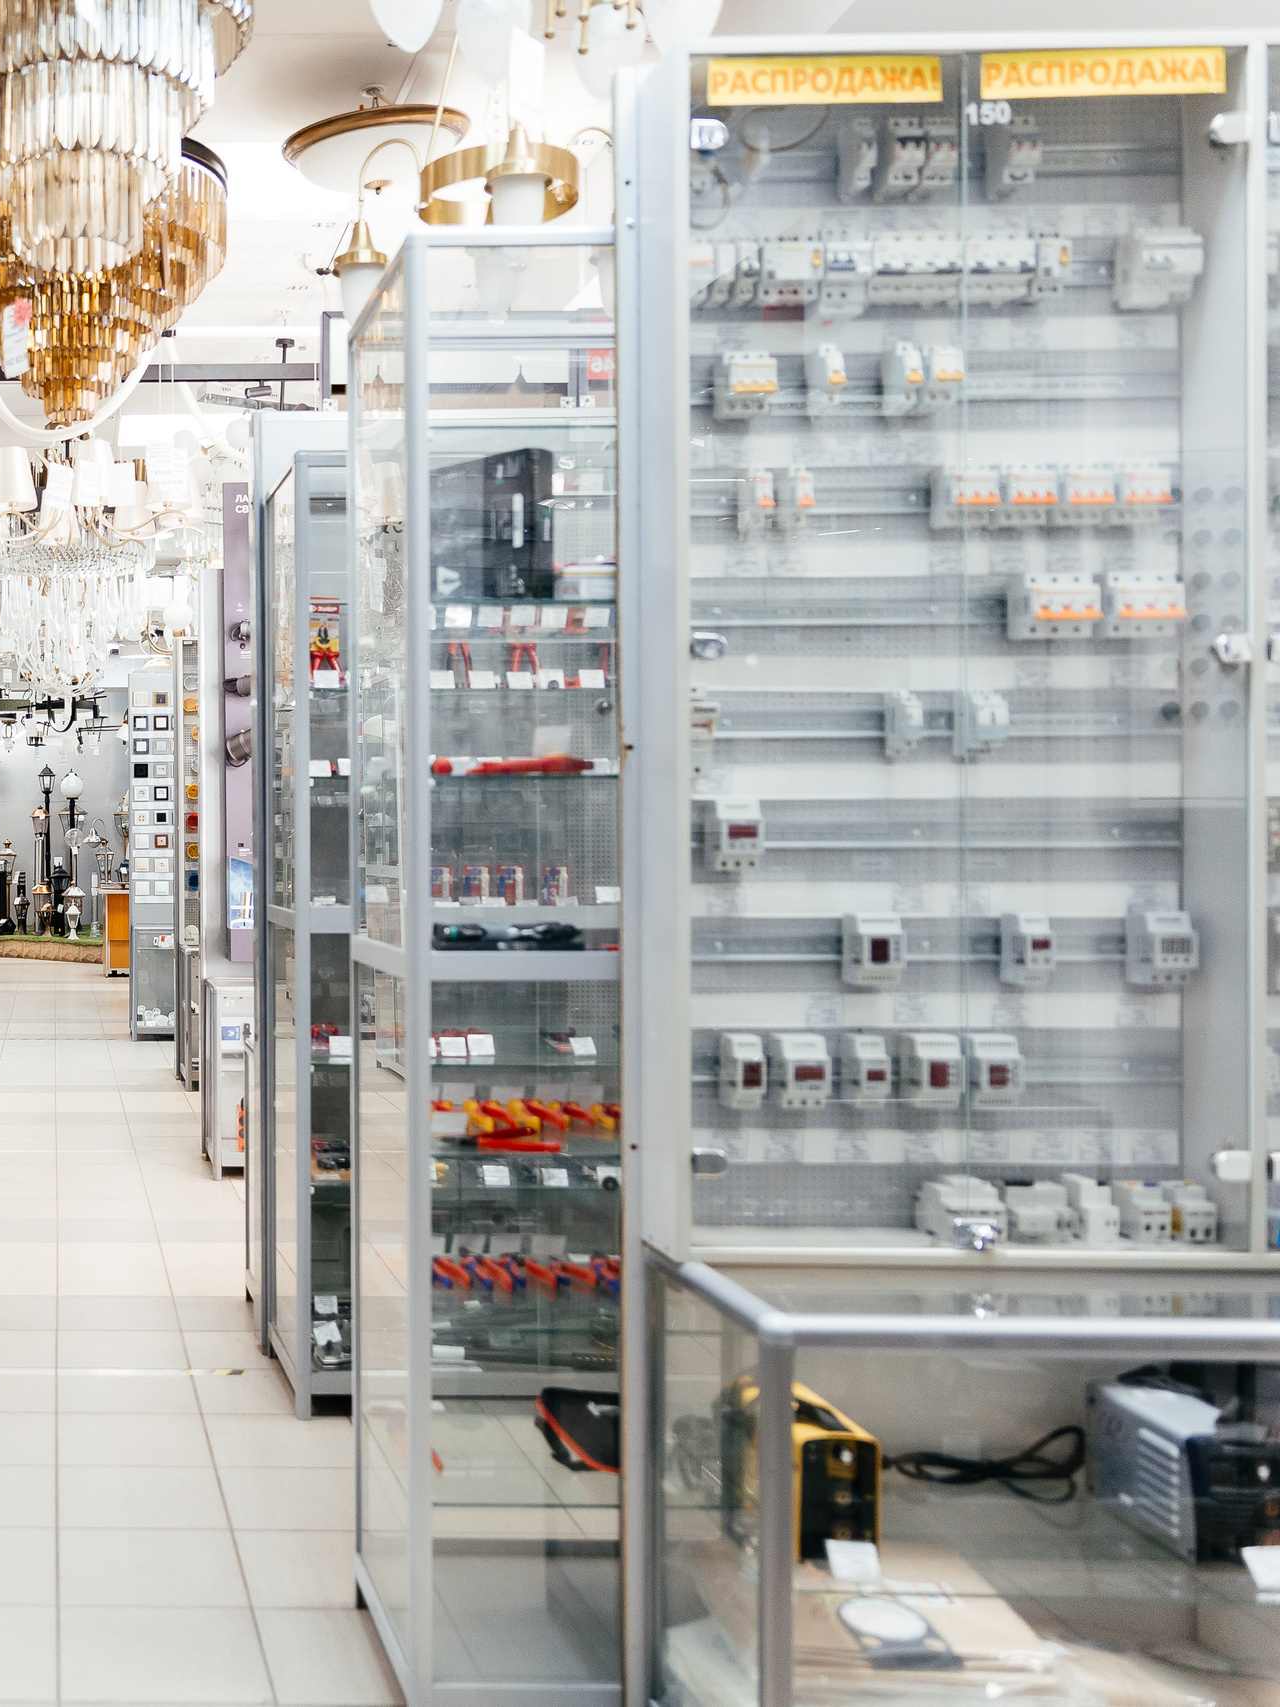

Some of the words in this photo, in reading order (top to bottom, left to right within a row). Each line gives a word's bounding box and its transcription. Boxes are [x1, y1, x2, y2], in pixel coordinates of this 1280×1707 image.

[710, 66, 940, 97] РАСПРОДАЖА!
[984, 57, 1223, 89] РАСПРОДАЖА!
[964, 101, 1013, 125] 150
